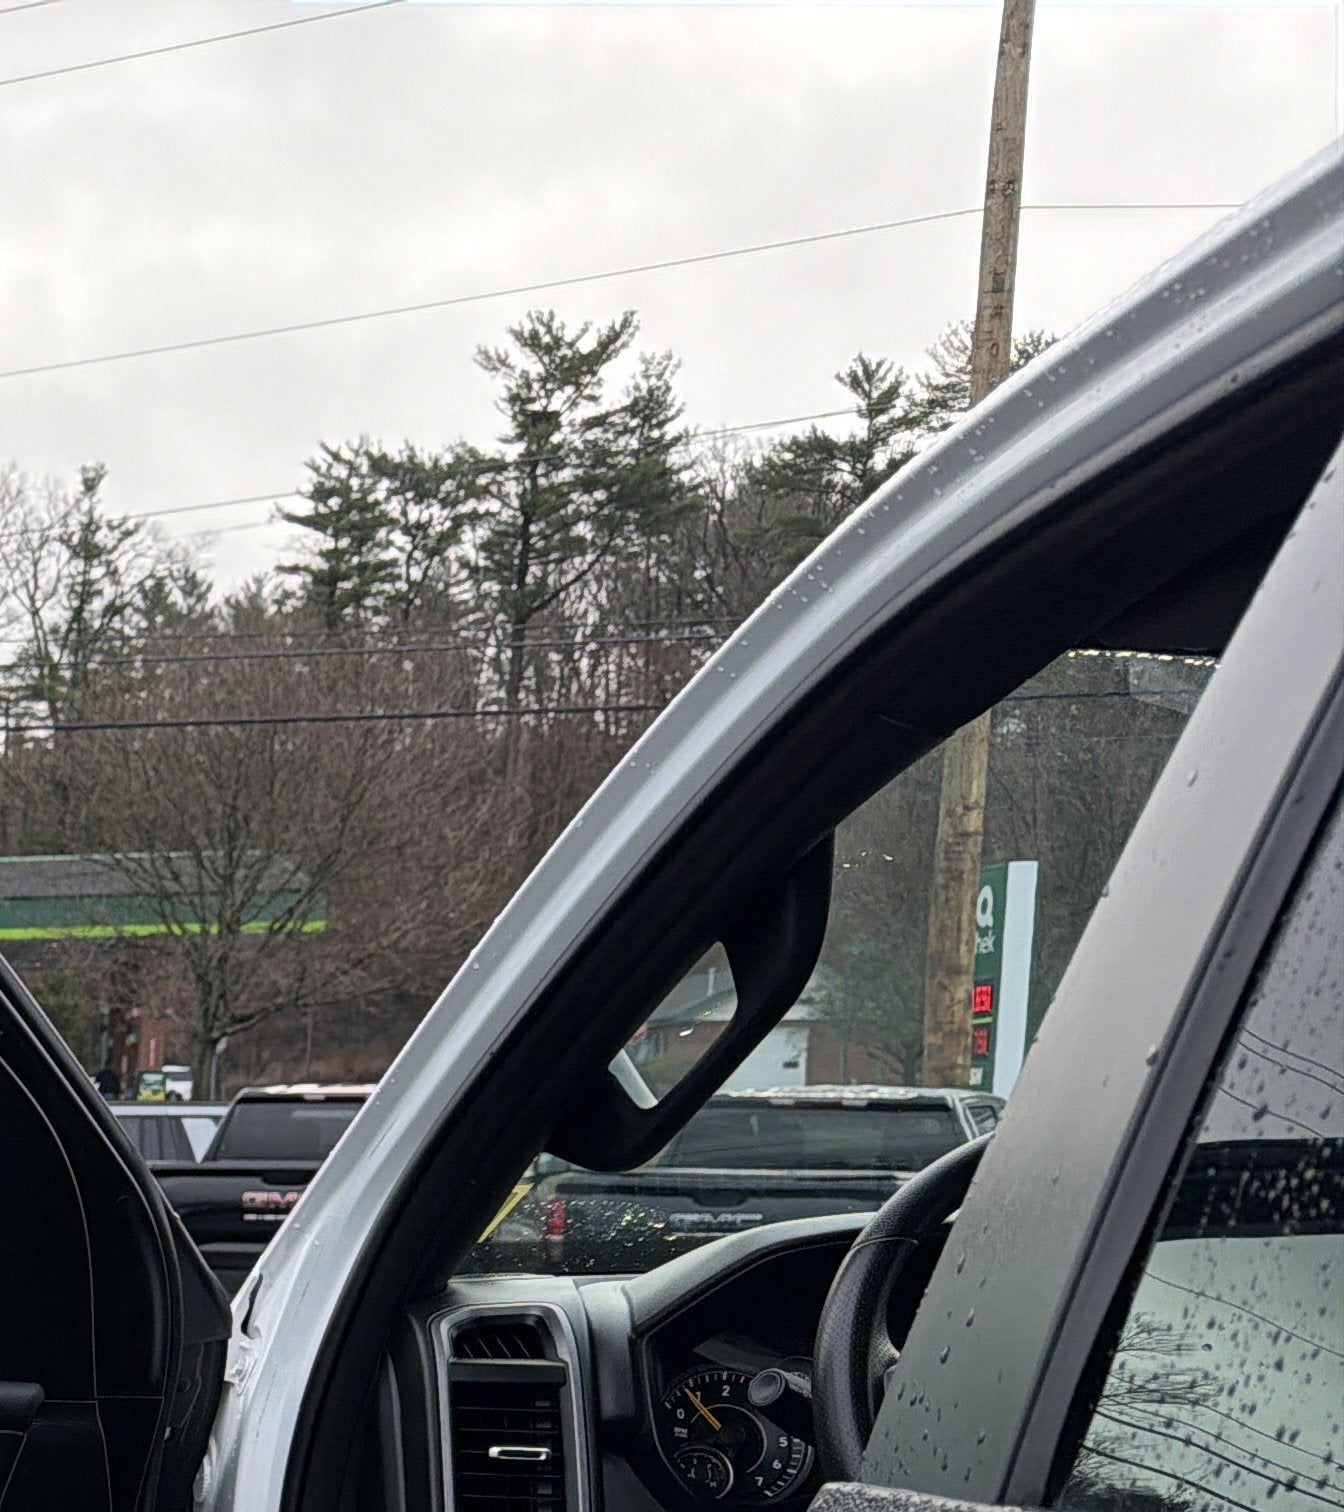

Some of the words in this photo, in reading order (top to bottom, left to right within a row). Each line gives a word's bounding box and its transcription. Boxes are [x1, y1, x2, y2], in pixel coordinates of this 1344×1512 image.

[242, 1191, 299, 1208] GM
[721, 1384, 731, 1397] 2
[676, 1408, 685, 1420] 0
[778, 1436, 789, 1448] 5
[772, 1459, 782, 1470] 6
[754, 1476, 764, 1487] 7
